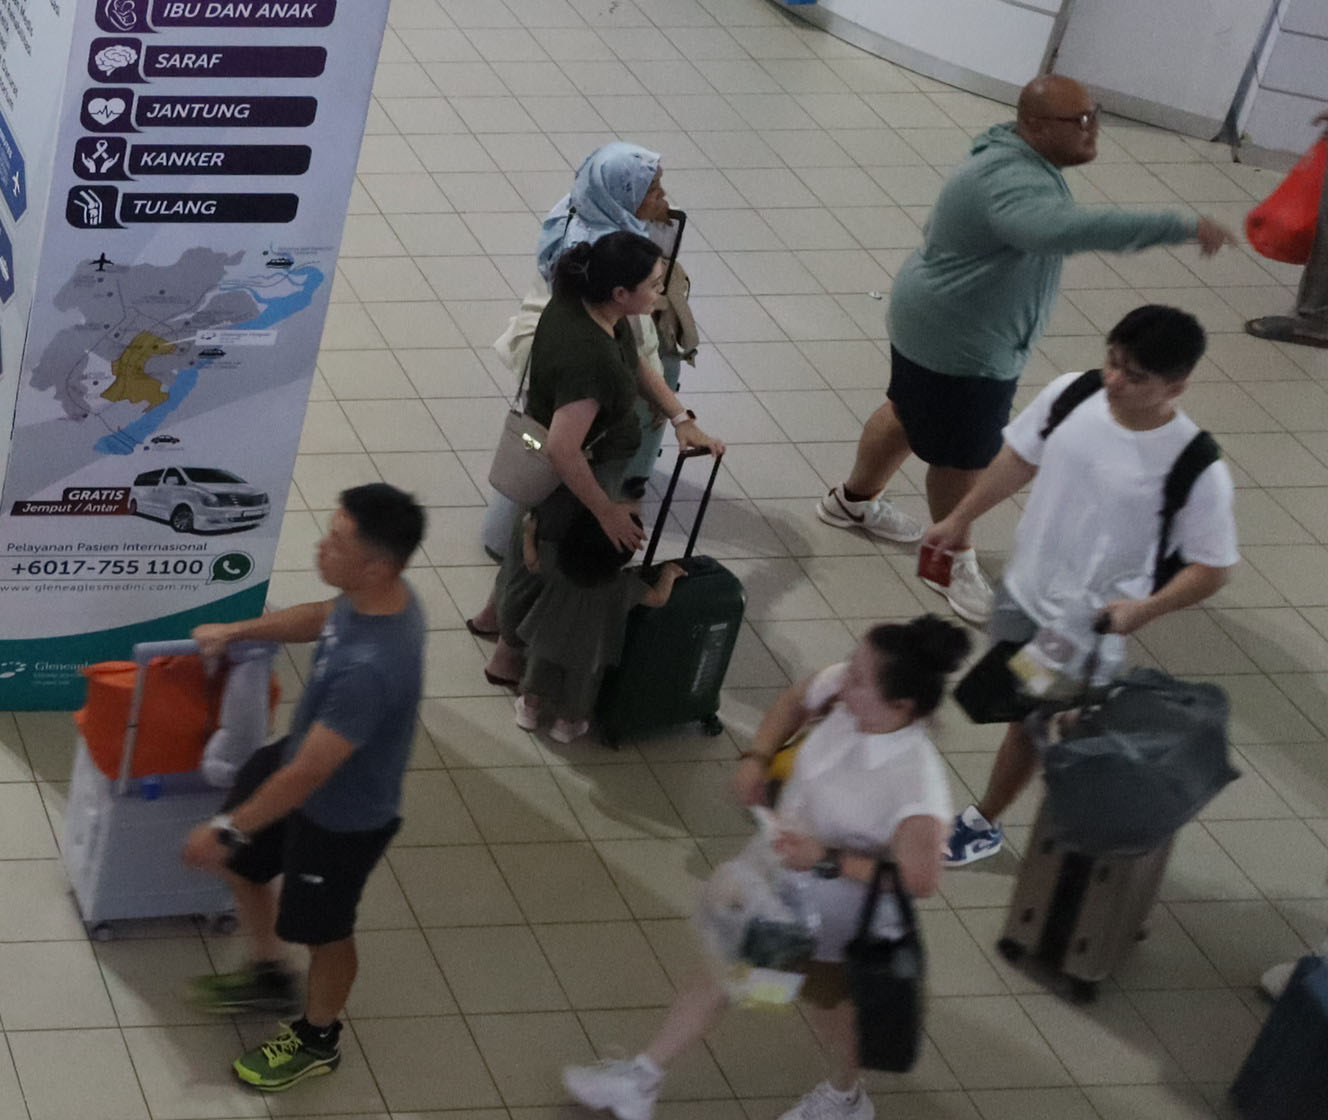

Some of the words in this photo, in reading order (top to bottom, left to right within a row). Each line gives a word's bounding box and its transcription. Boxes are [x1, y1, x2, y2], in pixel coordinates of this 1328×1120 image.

[163, 3, 202, 18] IBU
[204, 3, 254, 18] DAN
[255, 3, 317, 18] ANAK
[155, 53, 223, 69] SARAF
[146, 103, 251, 119] JANTUNG
[140, 152, 225, 167] KANKER
[132, 200, 218, 215] TULANG
[68, 489, 125, 501] GRATIS
[22, 503, 72, 514] Jemput
[83, 503, 119, 513] Antar
[7, 542, 73, 553] Pelayanan
[77, 542, 119, 552] Pasien
[122, 542, 208, 552] Internasional
[11, 560, 140, 575] +6017-755
[146, 560, 204, 574] 1100
